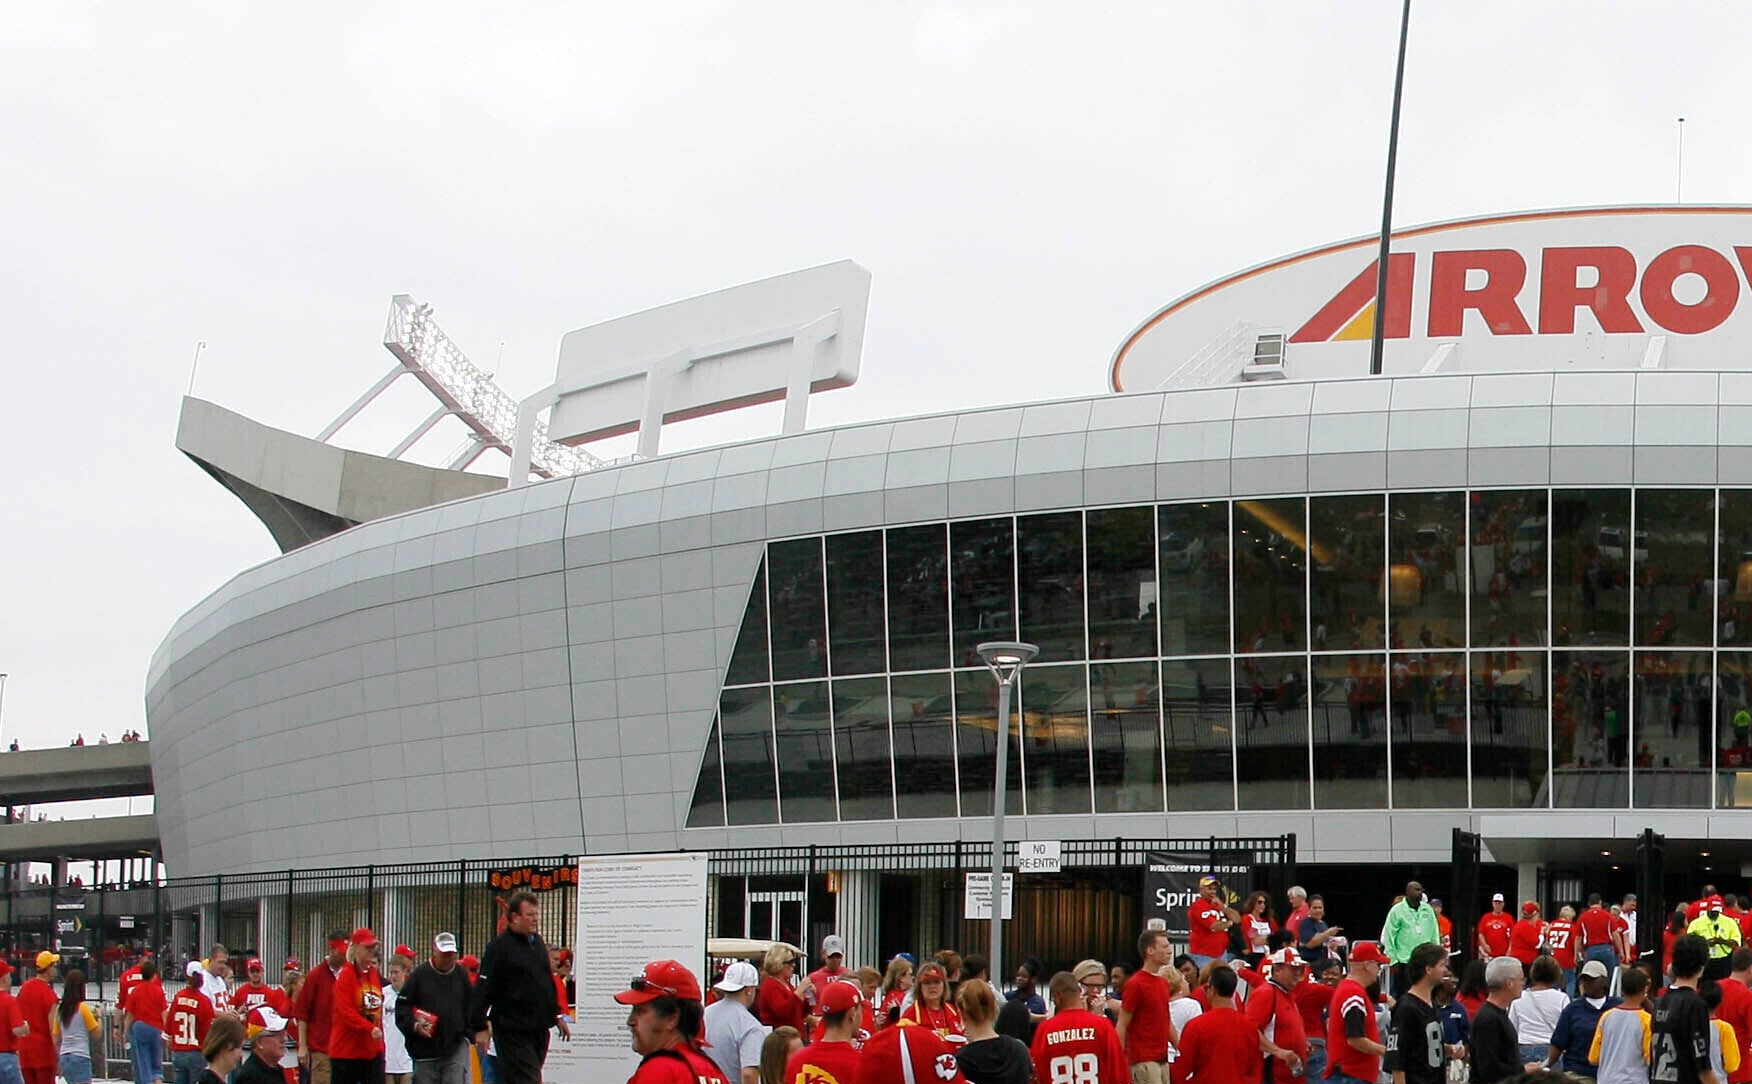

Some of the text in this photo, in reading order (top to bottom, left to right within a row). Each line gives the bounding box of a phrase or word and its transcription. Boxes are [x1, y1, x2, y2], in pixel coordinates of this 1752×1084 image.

[1033, 844, 1046, 854] NO
[1020, 858, 1059, 868] RE-ENTRY
[1149, 864, 1188, 872] WELCOME
[491, 867, 578, 890] SOUVENIRS
[1549, 930, 1570, 950] 27
[174, 1011, 199, 1046] 31
[1047, 1027, 1096, 1046] GONZALEZ
[1387, 1033, 1398, 1051] 81
